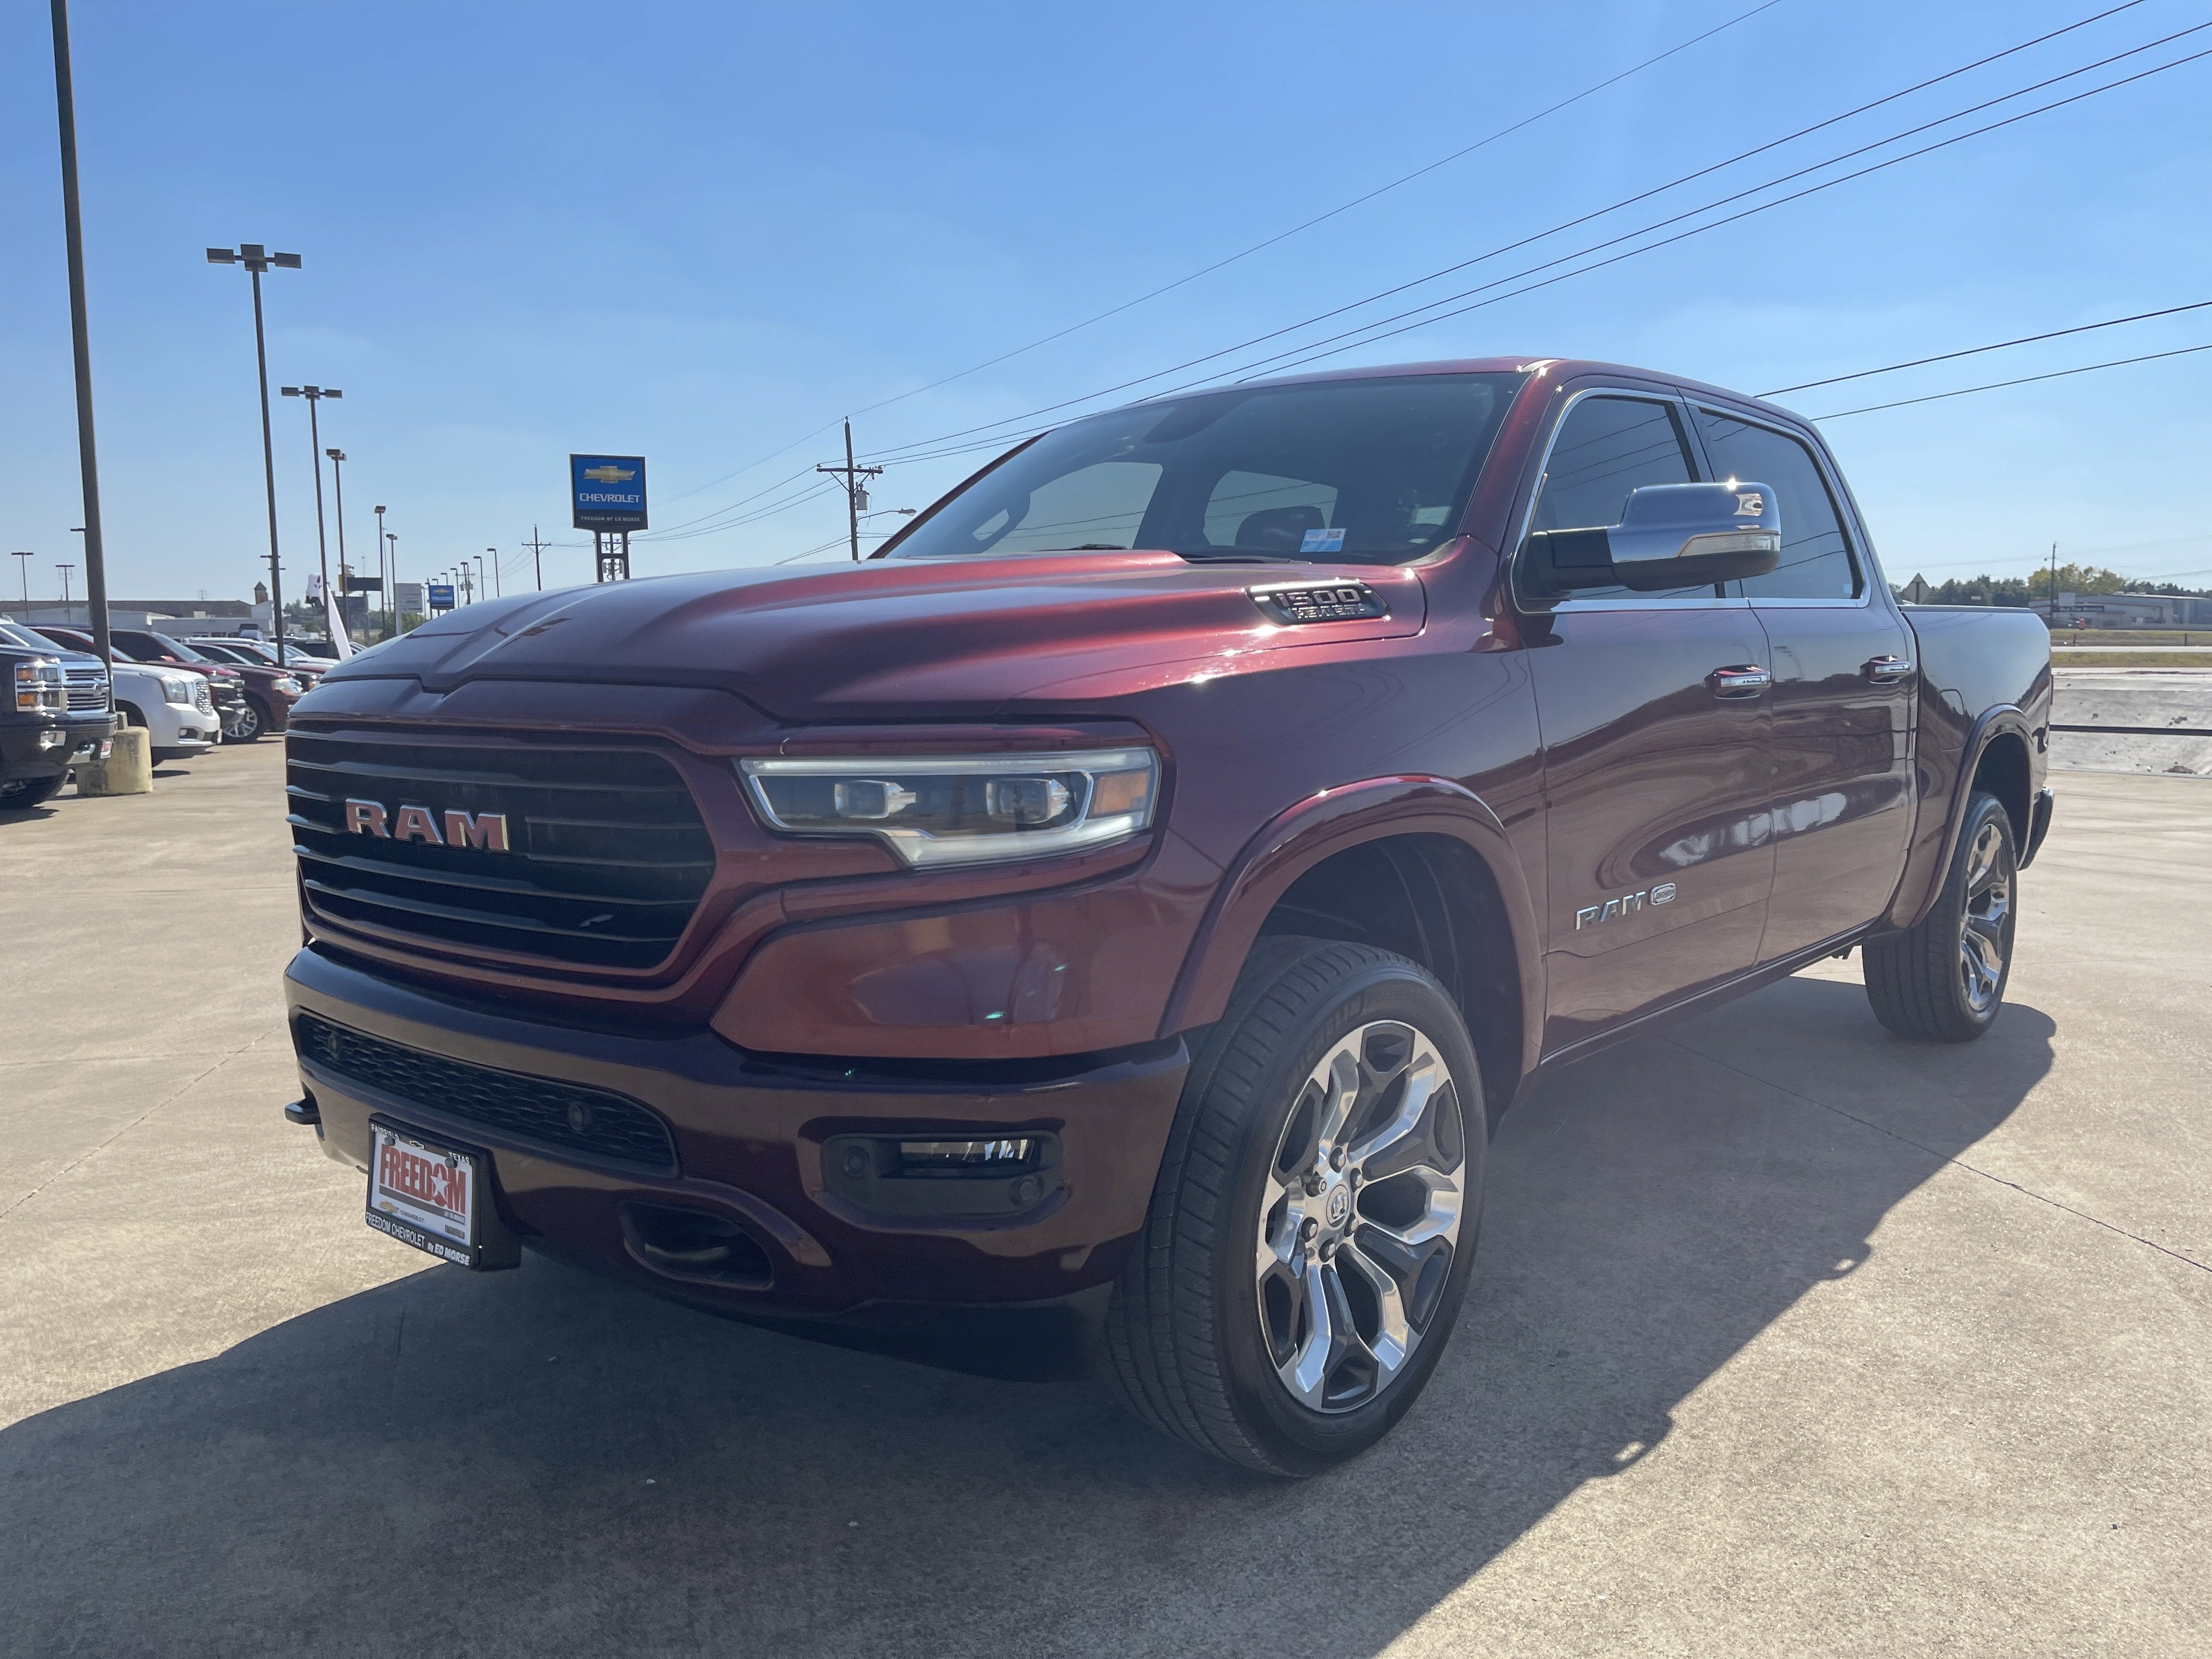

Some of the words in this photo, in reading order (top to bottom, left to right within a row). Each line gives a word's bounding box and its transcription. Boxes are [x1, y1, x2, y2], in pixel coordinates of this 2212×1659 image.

[579, 493, 641, 503] CHEVROLET
[1276, 589, 1361, 607] 1500
[346, 798, 509, 851] RAM
[1576, 891, 1646, 930] RAM
[371, 1124, 400, 1141] FAIRFIELD
[448, 1151, 470, 1165] TEXAS
[380, 1143, 466, 1215] FREEDOM
[366, 1211, 391, 1233] FREEDOM
[391, 1223, 425, 1248] CHEVROLET
[434, 1243, 444, 1256] ED
[444, 1246, 470, 1266] MORSE
